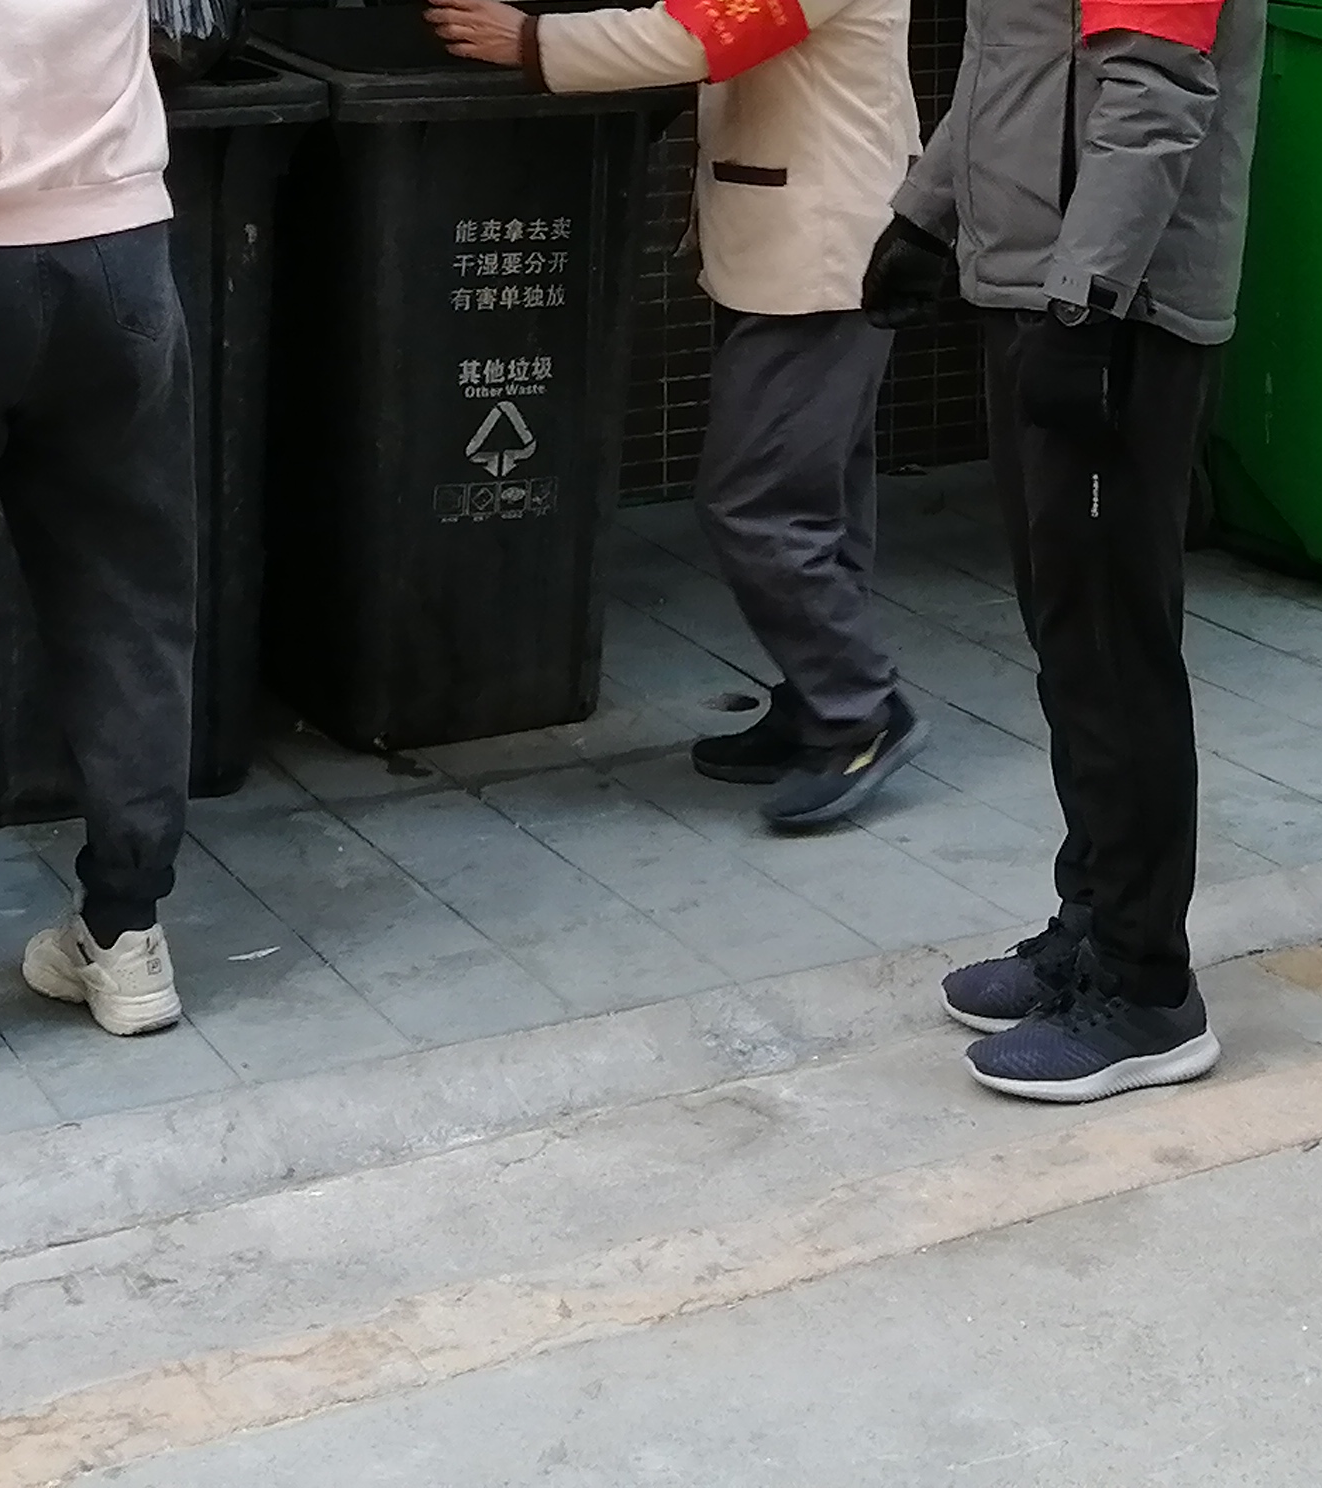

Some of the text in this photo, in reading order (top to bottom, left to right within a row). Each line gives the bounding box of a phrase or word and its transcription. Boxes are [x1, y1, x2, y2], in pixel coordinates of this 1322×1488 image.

[454, 216, 573, 244] 能卖拿去卖
[452, 251, 569, 278] 干湿要分开
[449, 283, 567, 311] 有害单独放
[457, 355, 554, 386] 其他垃圾
[464, 382, 546, 399] Other Waste
